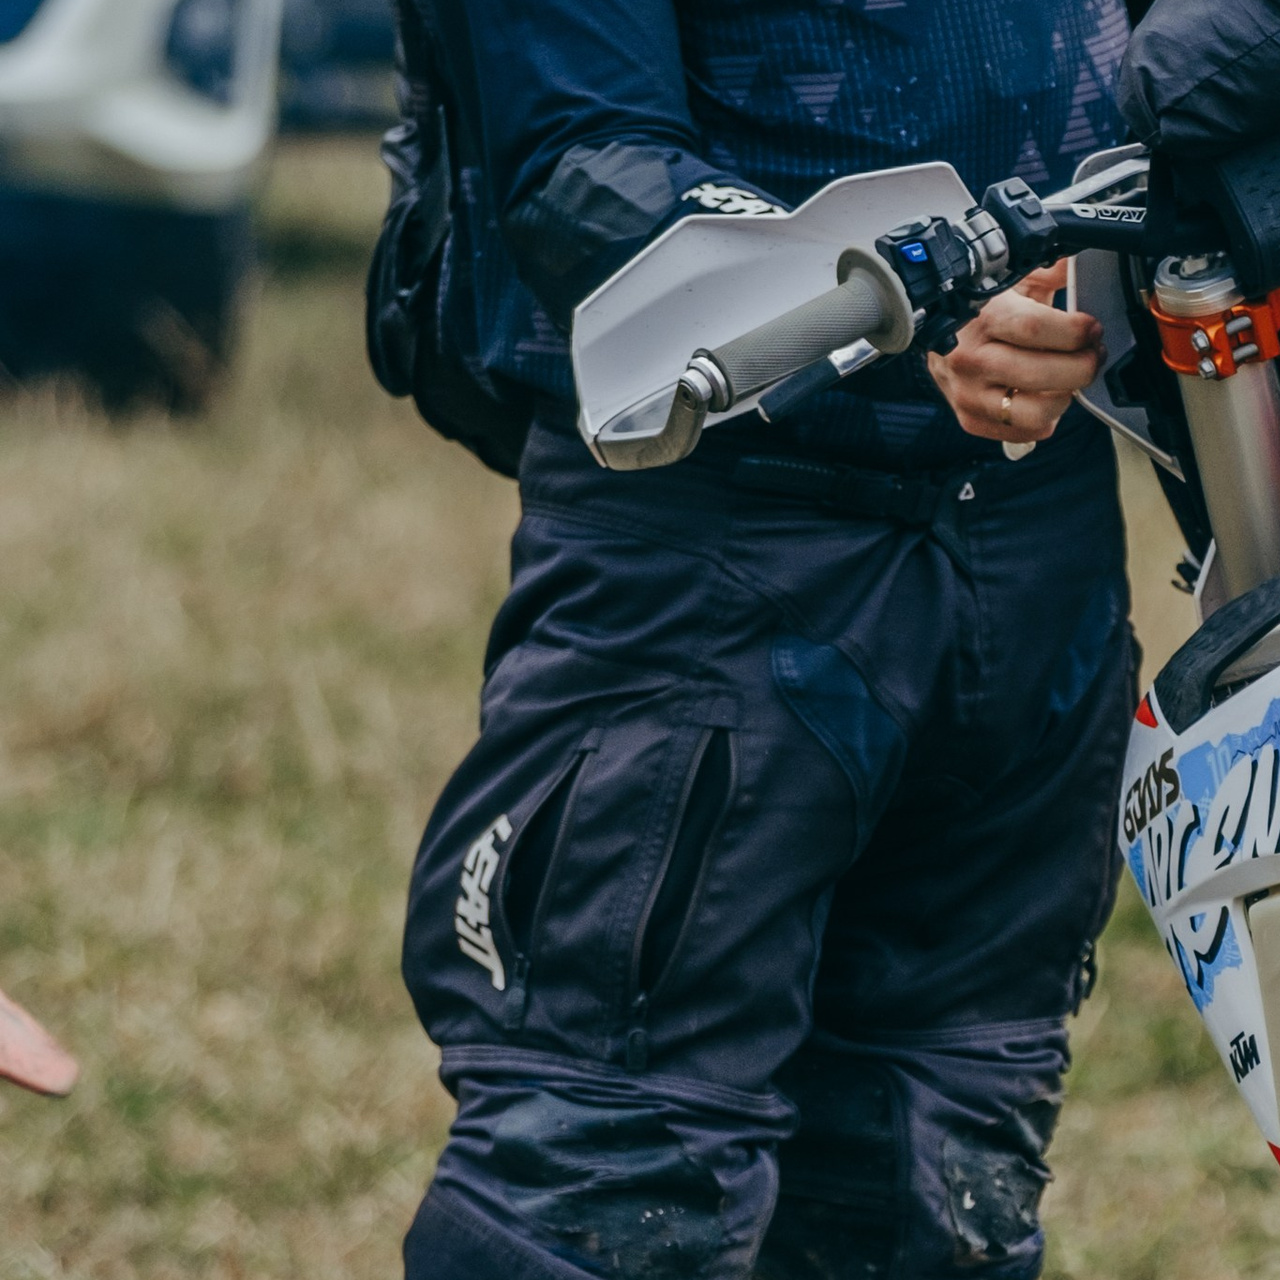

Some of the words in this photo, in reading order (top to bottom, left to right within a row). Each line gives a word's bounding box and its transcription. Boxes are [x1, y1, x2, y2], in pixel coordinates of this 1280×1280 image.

[1123, 746, 1180, 844] 6DAYS
[454, 813, 514, 992] LEATT
[1229, 1030, 1261, 1084] KTM
